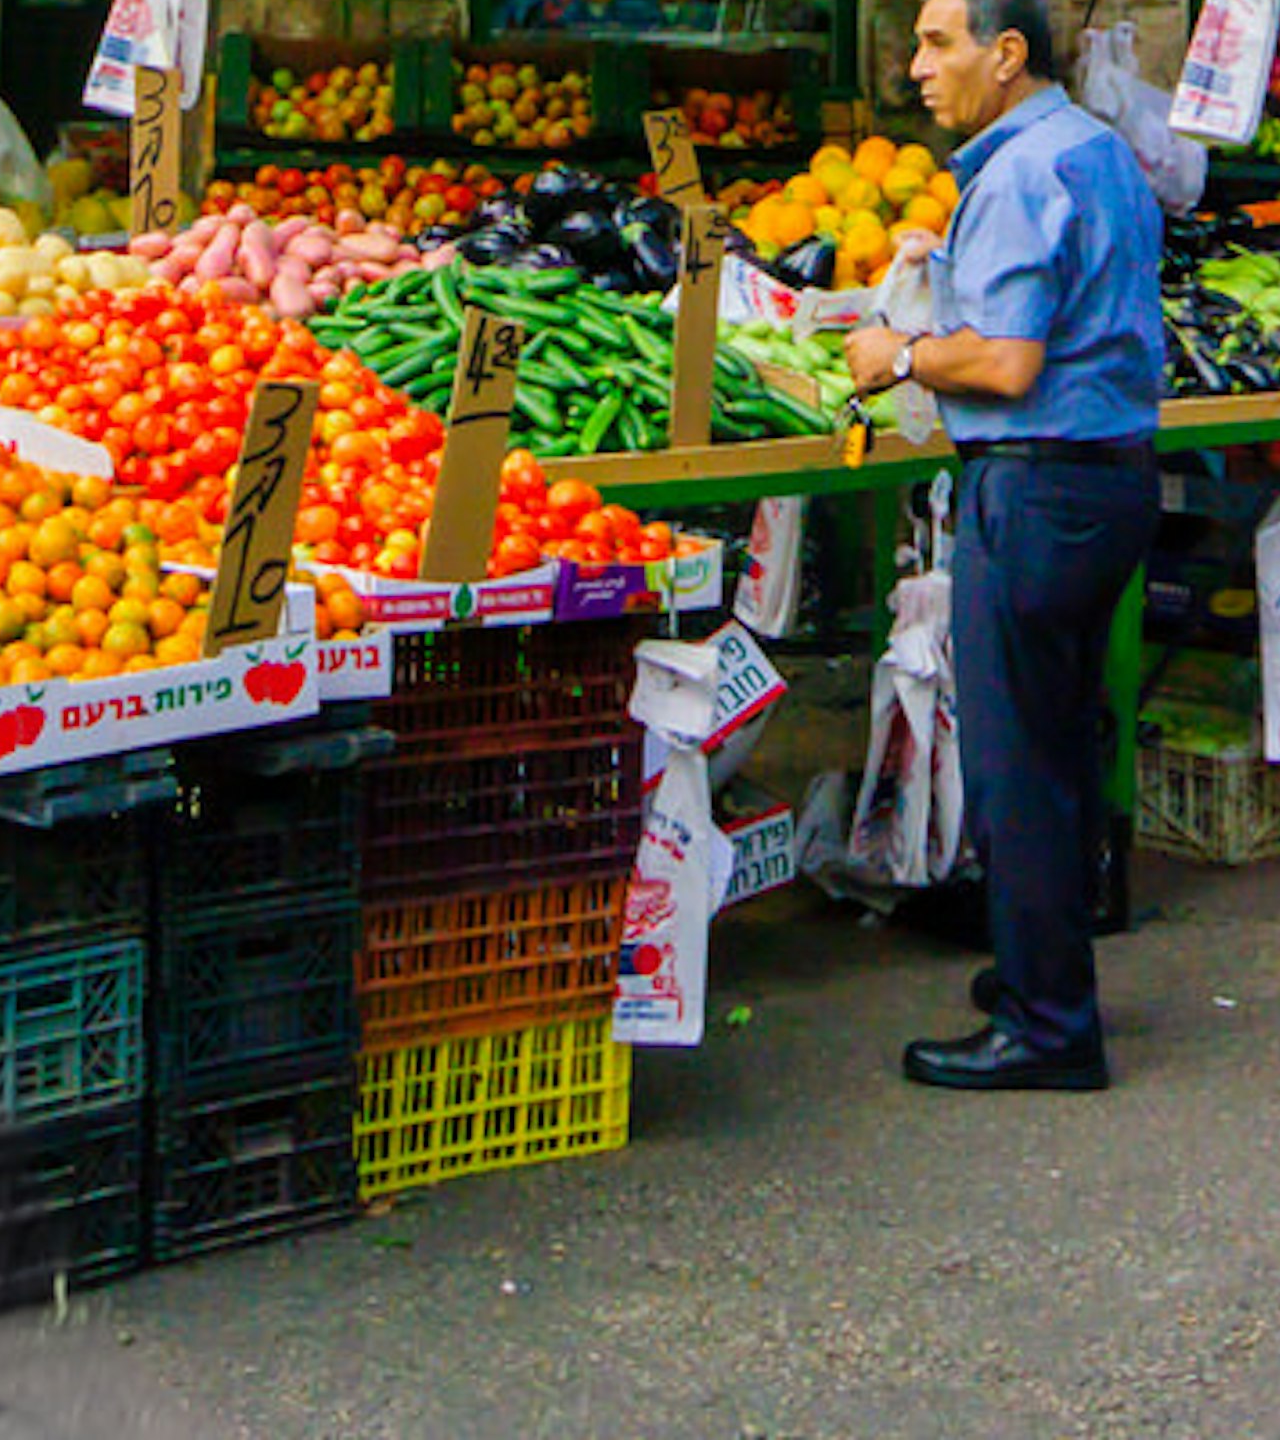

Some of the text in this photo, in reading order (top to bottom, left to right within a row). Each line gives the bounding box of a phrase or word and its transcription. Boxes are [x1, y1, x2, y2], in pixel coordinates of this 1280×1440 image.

[242, 383, 304, 465] 3
[214, 512, 288, 639] 10
[60, 677, 233, 732] פירות ברעם
